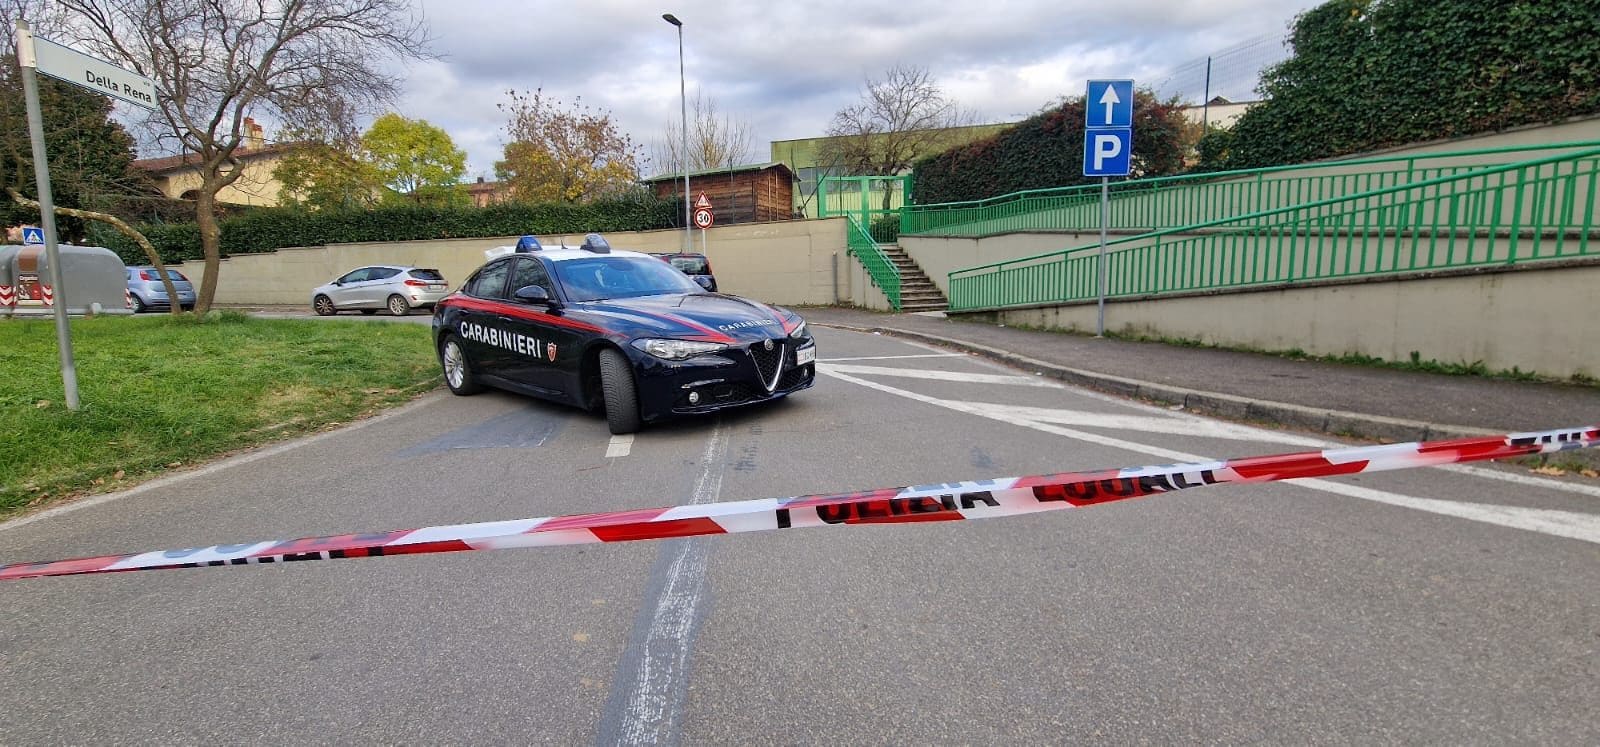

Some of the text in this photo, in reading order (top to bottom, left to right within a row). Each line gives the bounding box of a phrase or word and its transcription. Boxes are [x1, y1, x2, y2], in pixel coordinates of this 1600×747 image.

[86, 70, 152, 103] Della Rena
[1093, 134, 1122, 170] P
[698, 213, 709, 223] 30
[460, 321, 541, 358] CARABINIERI
